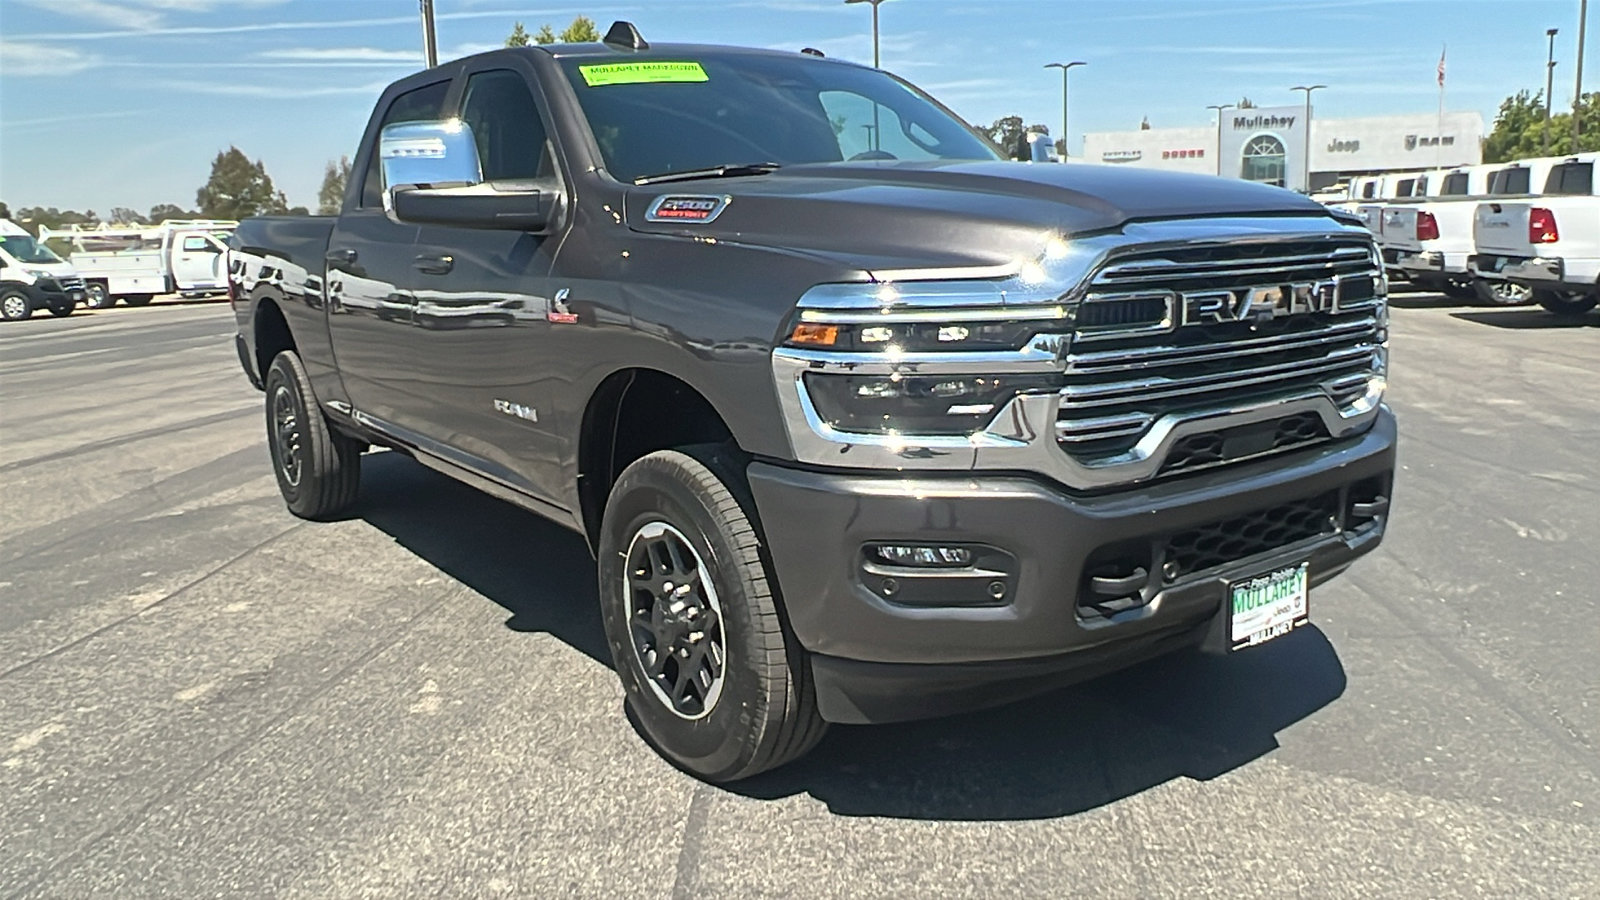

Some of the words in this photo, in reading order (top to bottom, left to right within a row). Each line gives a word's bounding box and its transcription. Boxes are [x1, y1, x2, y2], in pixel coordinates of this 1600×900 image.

[1233, 115, 1295, 130] Mullahey
[1327, 138, 1360, 153] Jeep
[1419, 136, 1454, 146] RAM
[1162, 149, 1205, 160] DODGE
[663, 199, 715, 210] 2500
[1181, 281, 1339, 326] RAM
[493, 399, 538, 422] RAM
[1233, 570, 1304, 614] MULLAHEY
